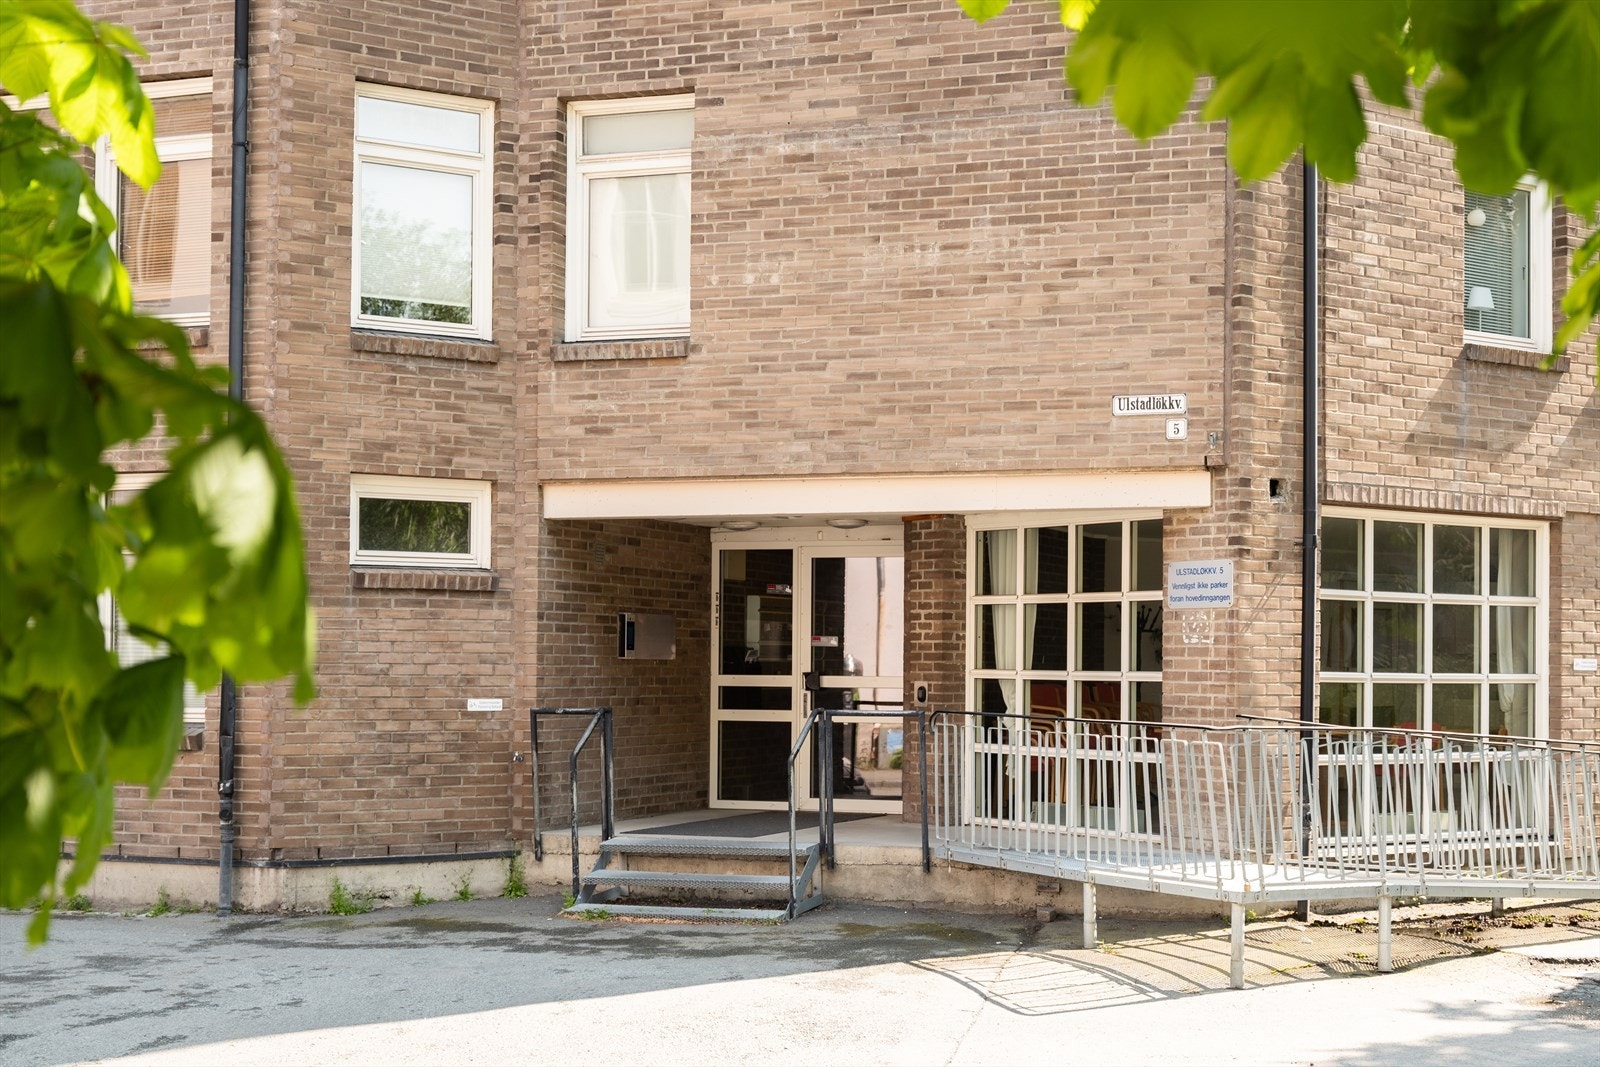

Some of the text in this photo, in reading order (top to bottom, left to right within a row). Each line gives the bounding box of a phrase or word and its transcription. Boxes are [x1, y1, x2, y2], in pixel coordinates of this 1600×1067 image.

[1118, 396, 1182, 411] Ulstadlökkv.
[1173, 423, 1180, 435] 5
[1220, 566, 1224, 574] 5
[1172, 582, 1196, 591] Vennligst
[1210, 581, 1228, 590] parker
[1185, 594, 1230, 602] hovedinngangen
